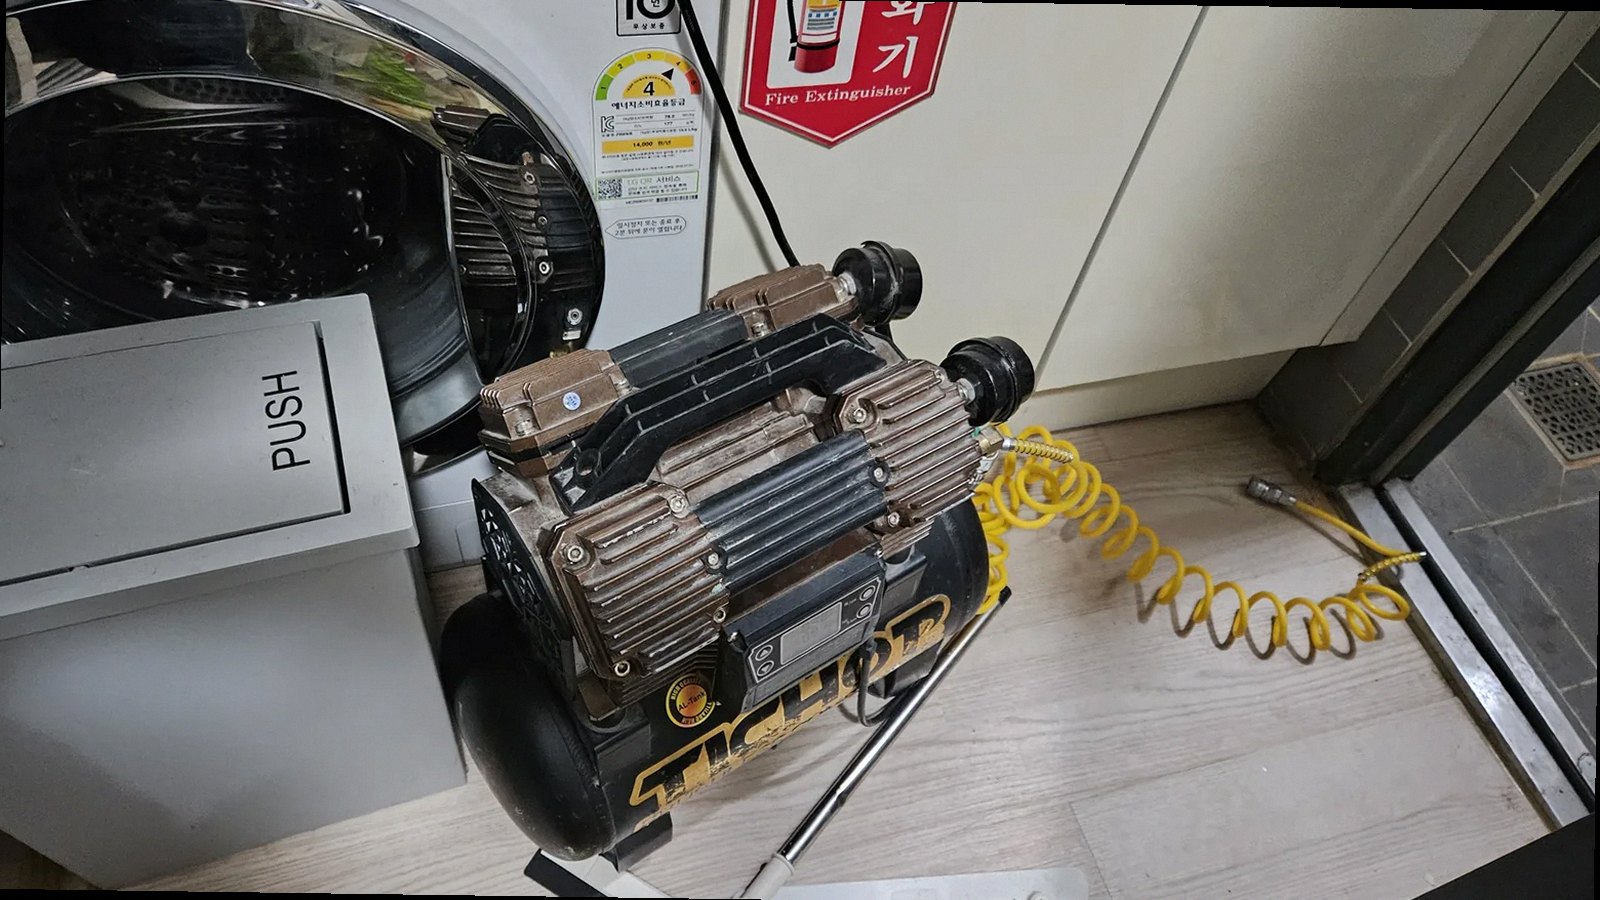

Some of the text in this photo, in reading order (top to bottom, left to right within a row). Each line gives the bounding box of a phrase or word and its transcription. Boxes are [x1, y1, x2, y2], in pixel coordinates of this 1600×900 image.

[643, 81, 655, 96] 4
[765, 85, 911, 106] Fire Extinguisher
[611, 98, 686, 109] 에너지소비효율등급
[656, 175, 681, 184] 서비스
[616, 221, 643, 229] 일시정지
[262, 370, 311, 471] PUSH
